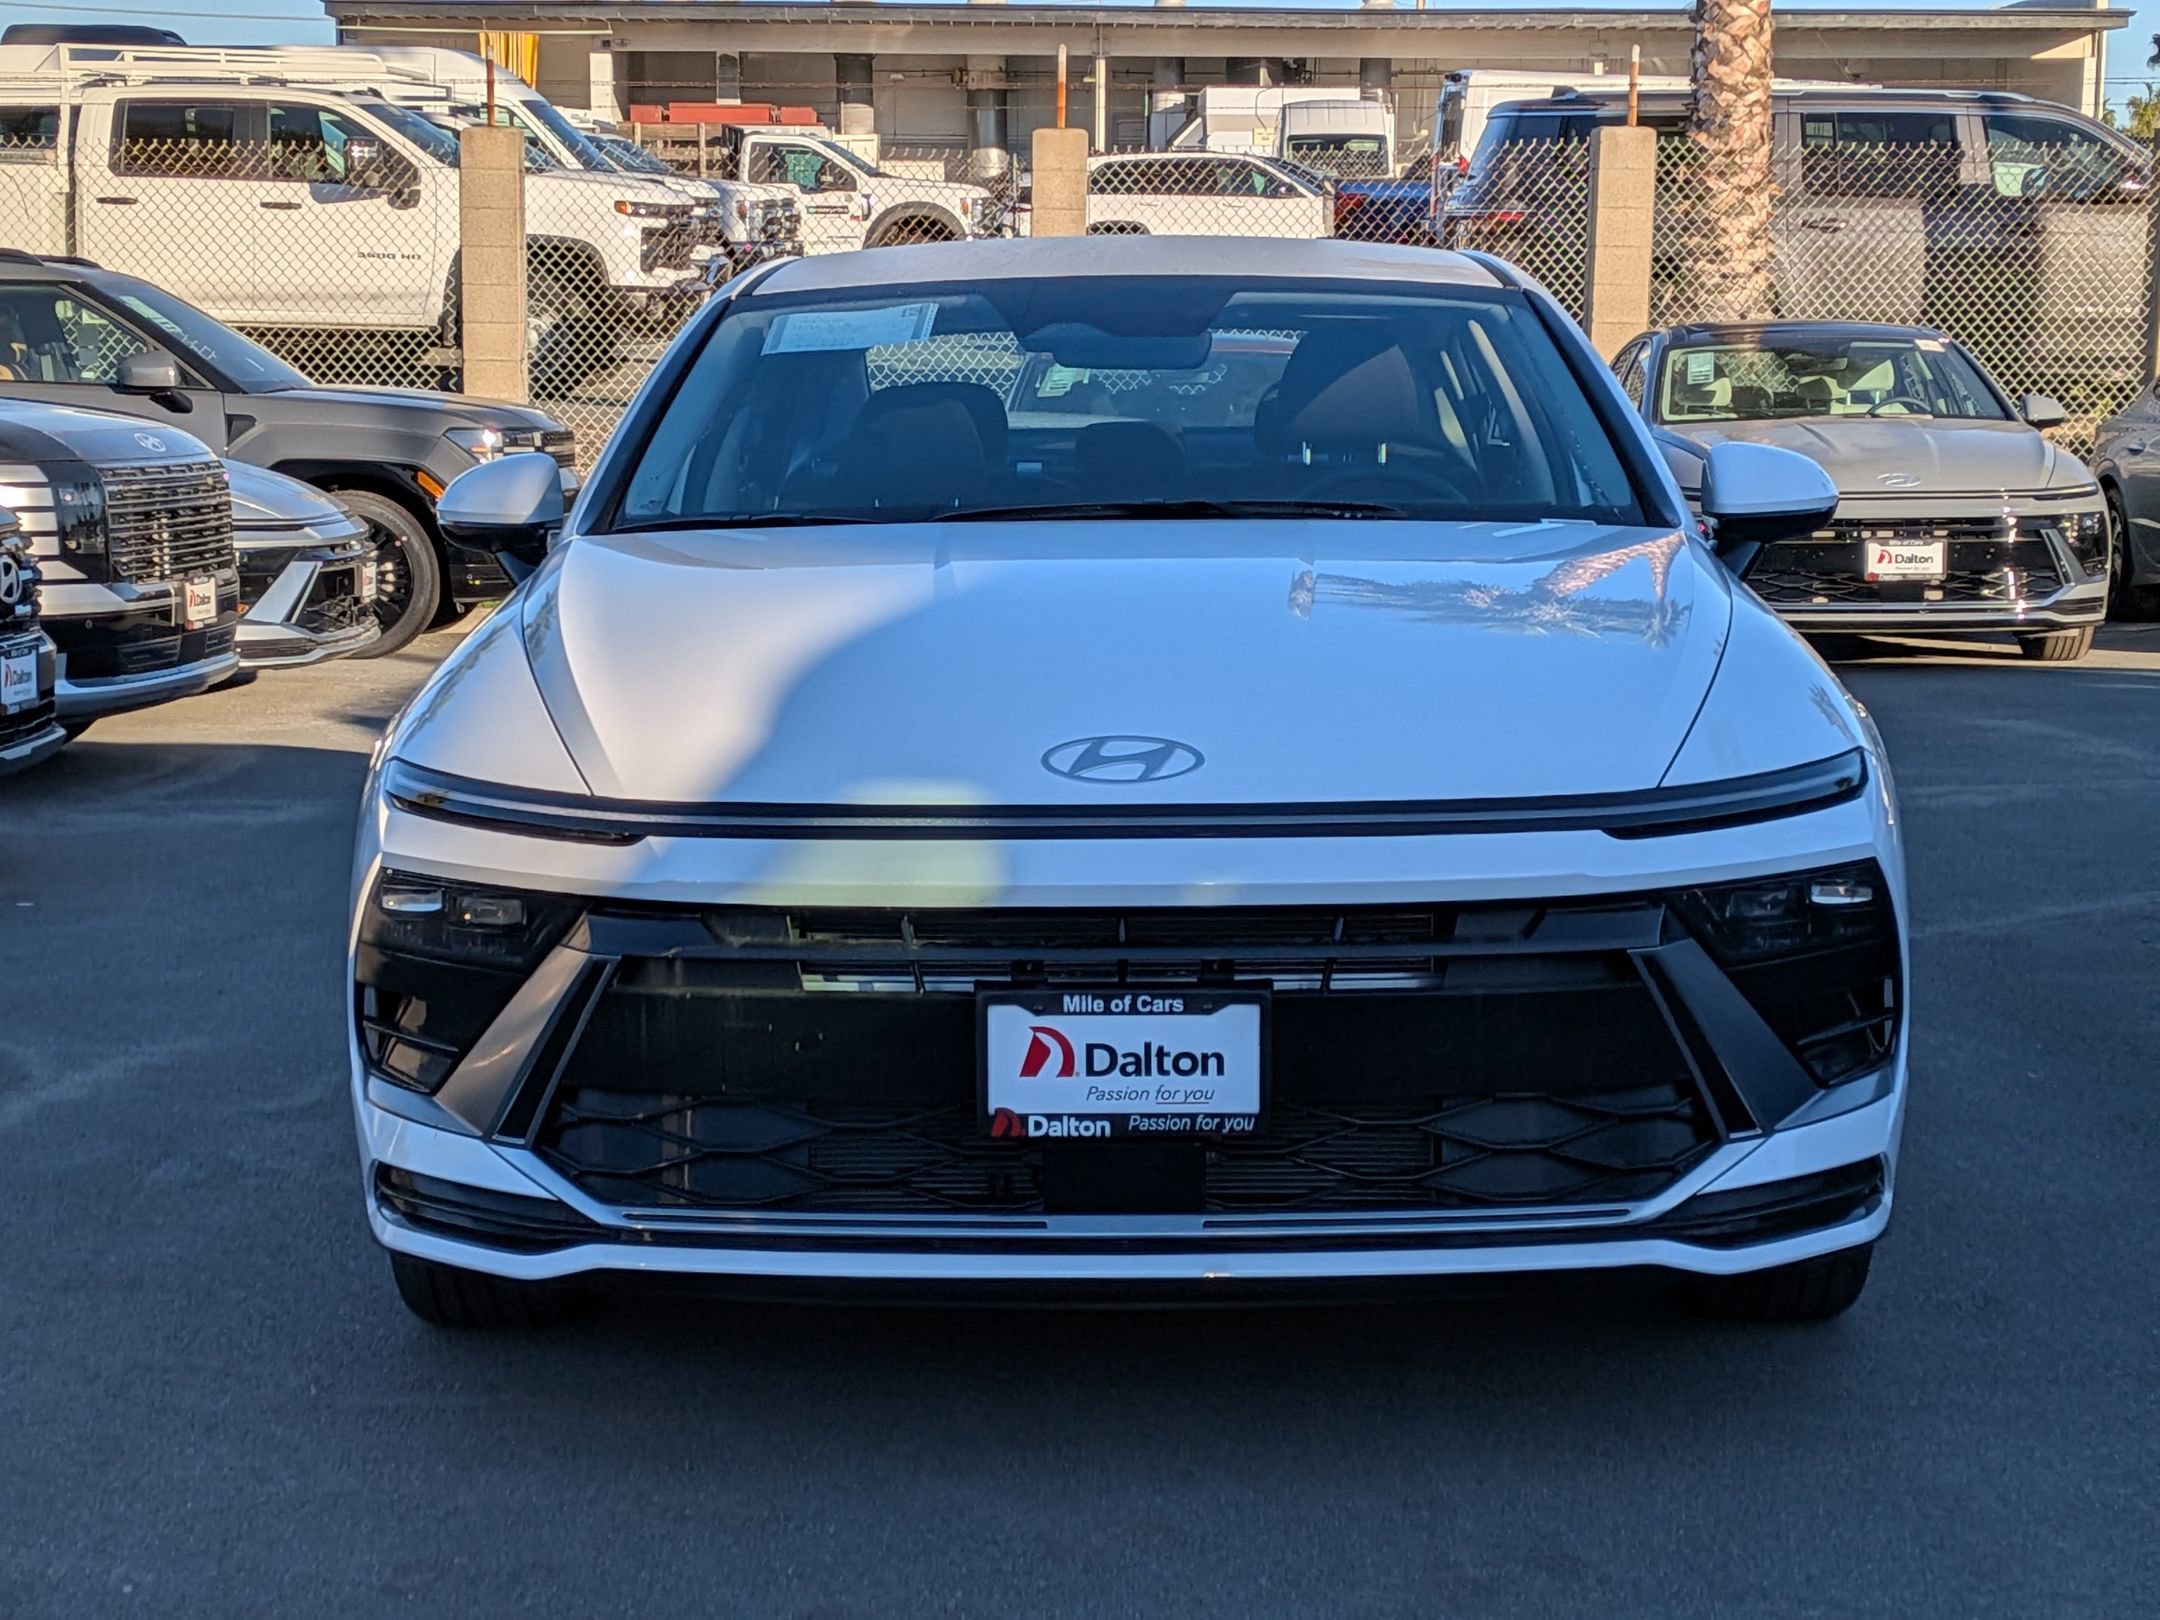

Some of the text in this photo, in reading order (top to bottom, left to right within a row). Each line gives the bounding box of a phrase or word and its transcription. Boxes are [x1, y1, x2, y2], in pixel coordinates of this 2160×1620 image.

[1895, 553, 1934, 564] Dalton
[1062, 994, 1184, 1013] Mile of Cars
[1085, 1041, 1225, 1077] Dalton
[1086, 1084, 1215, 1104] Passion for you
[1028, 1116, 1111, 1137] Dalton
[1128, 1115, 1254, 1133] Passion for you
